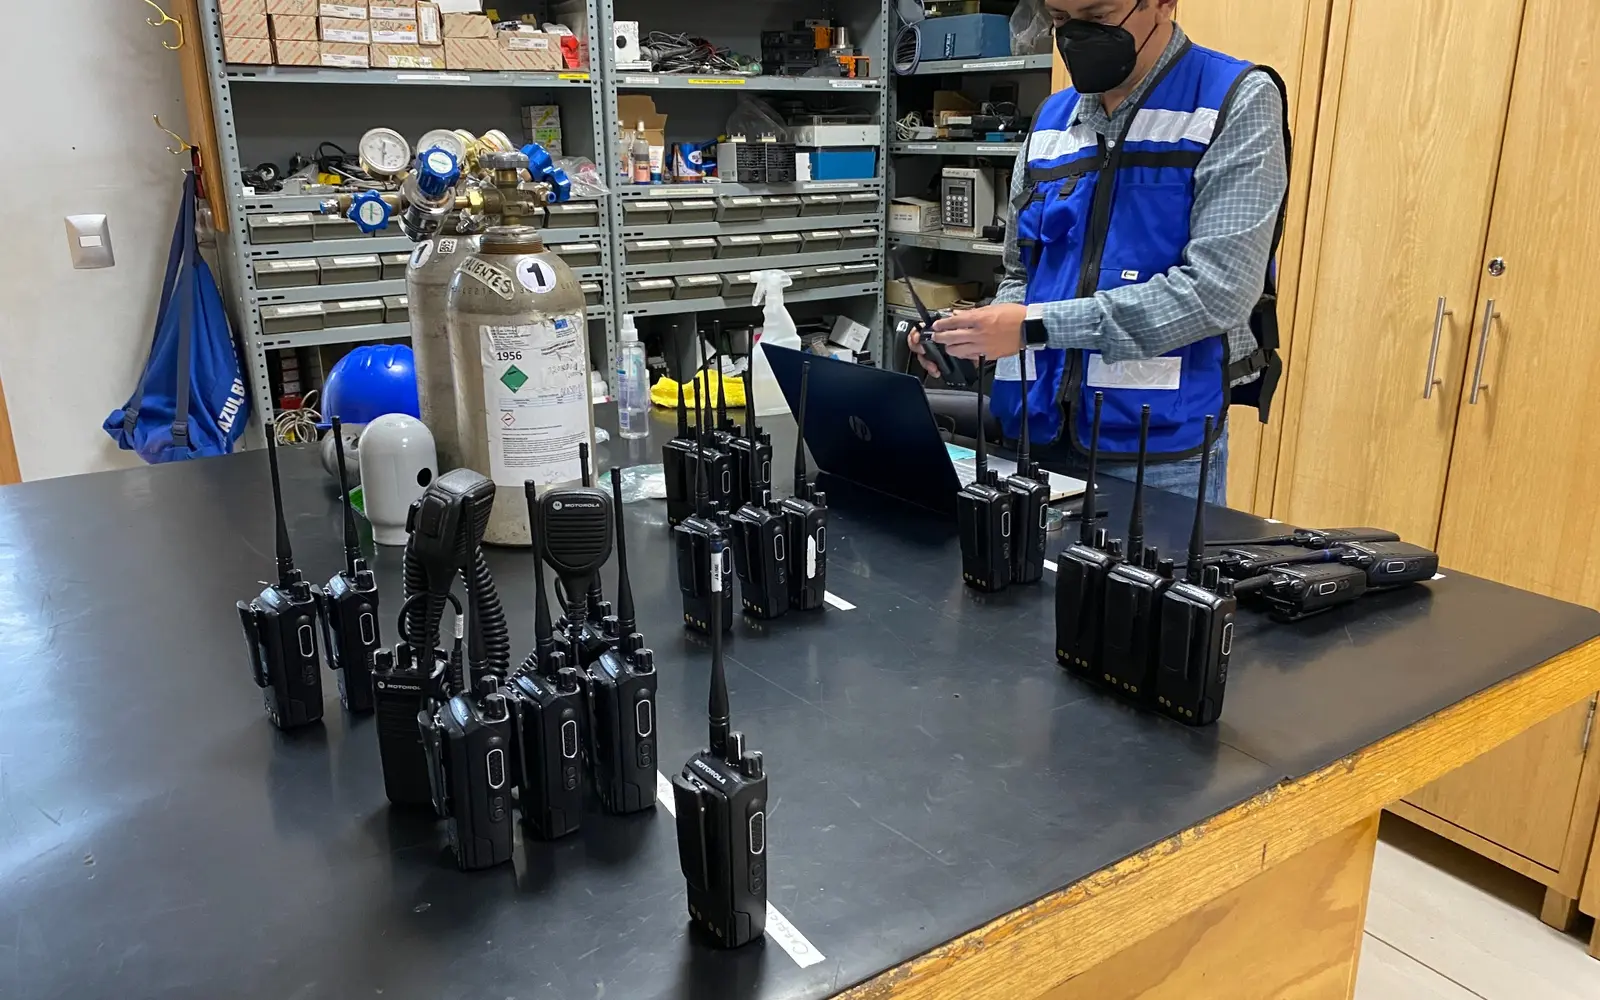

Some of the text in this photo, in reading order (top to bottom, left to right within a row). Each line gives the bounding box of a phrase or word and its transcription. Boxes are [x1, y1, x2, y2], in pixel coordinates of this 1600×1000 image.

[415, 244, 428, 264] 1
[462, 258, 512, 294] ALIENTES
[527, 263, 546, 287] 1
[497, 351, 522, 361] 1956
[386, 683, 422, 691] MOTOROL
[693, 759, 728, 786] MOTOROLA
